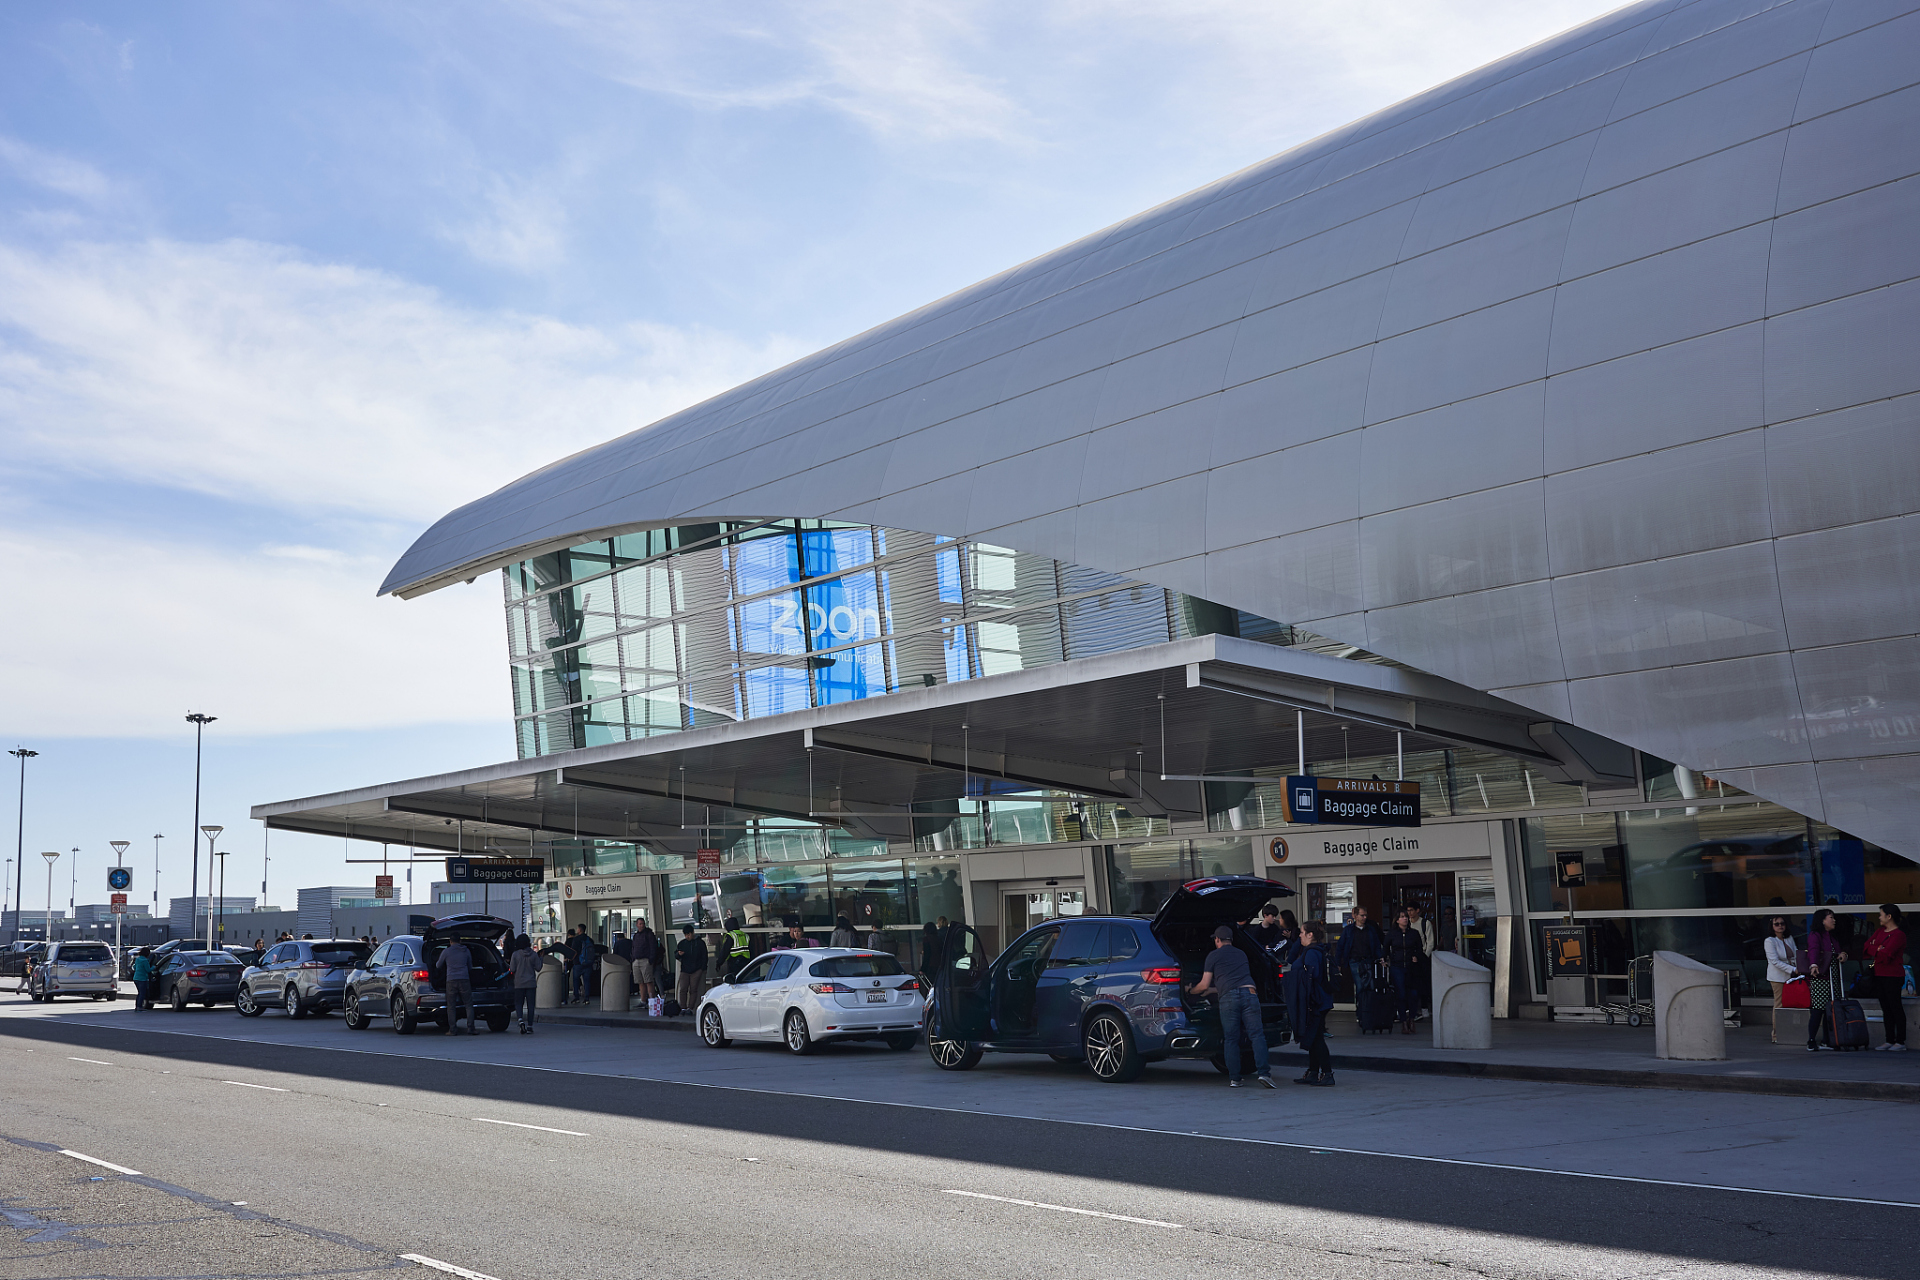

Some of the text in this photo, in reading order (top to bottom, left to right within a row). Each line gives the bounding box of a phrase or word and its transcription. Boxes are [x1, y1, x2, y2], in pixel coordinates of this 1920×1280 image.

[1336, 781, 1401, 793] ARRIVALS B
[1324, 798, 1413, 818] Baggage Claim
[1323, 836, 1419, 856] Baggage Claim
[473, 868, 539, 879] Baggage Claim
[116, 876, 122, 884] 5
[585, 883, 621, 895] Baggage Claim
[1844, 893, 1864, 903] zoom
